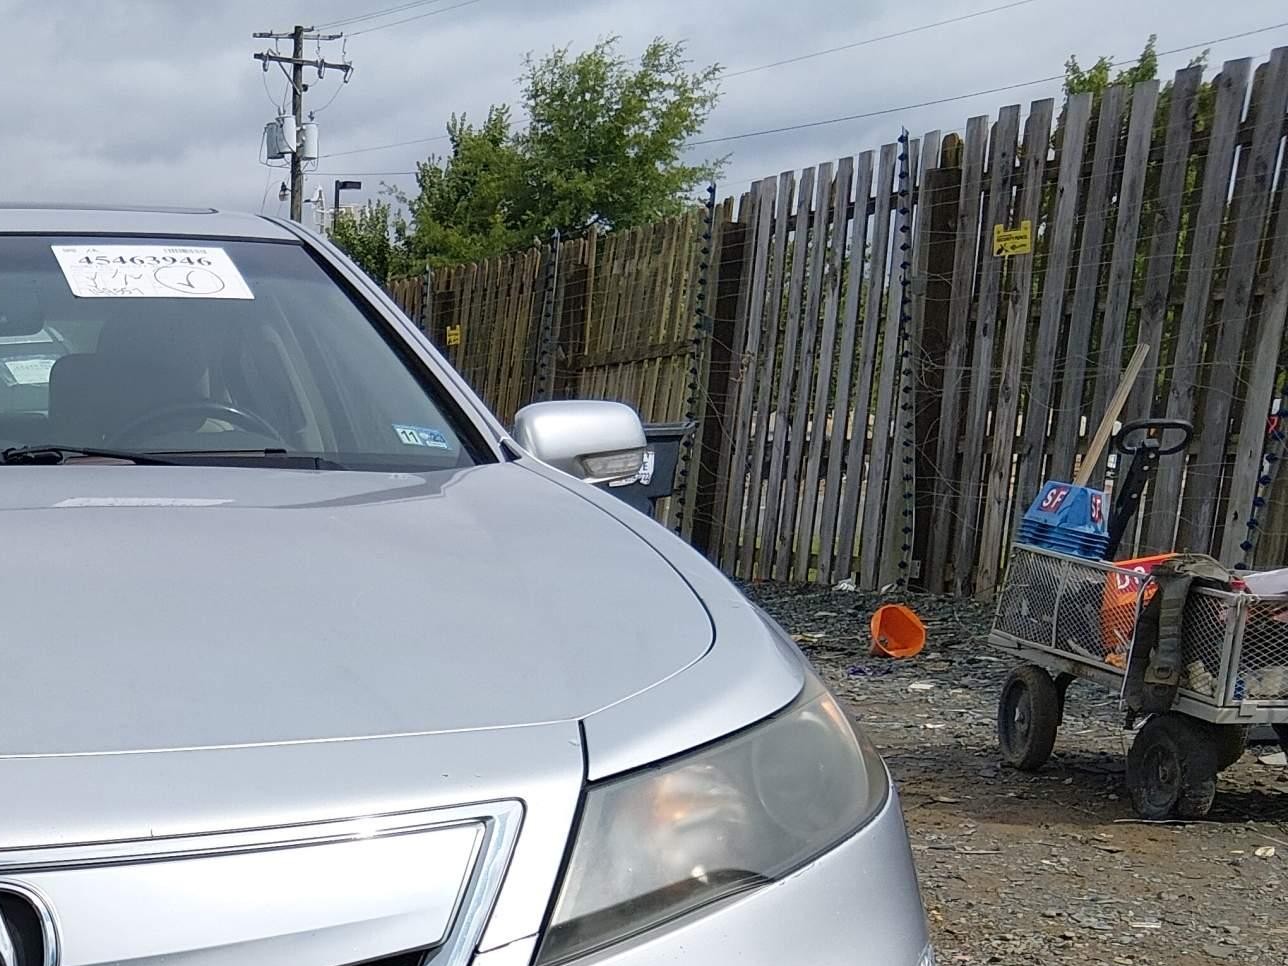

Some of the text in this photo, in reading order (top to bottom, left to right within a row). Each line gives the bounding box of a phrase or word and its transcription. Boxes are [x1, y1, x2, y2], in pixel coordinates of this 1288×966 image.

[78, 255, 212, 267] 45463946
[401, 430, 418, 443] 11
[1042, 488, 1068, 508] SF
